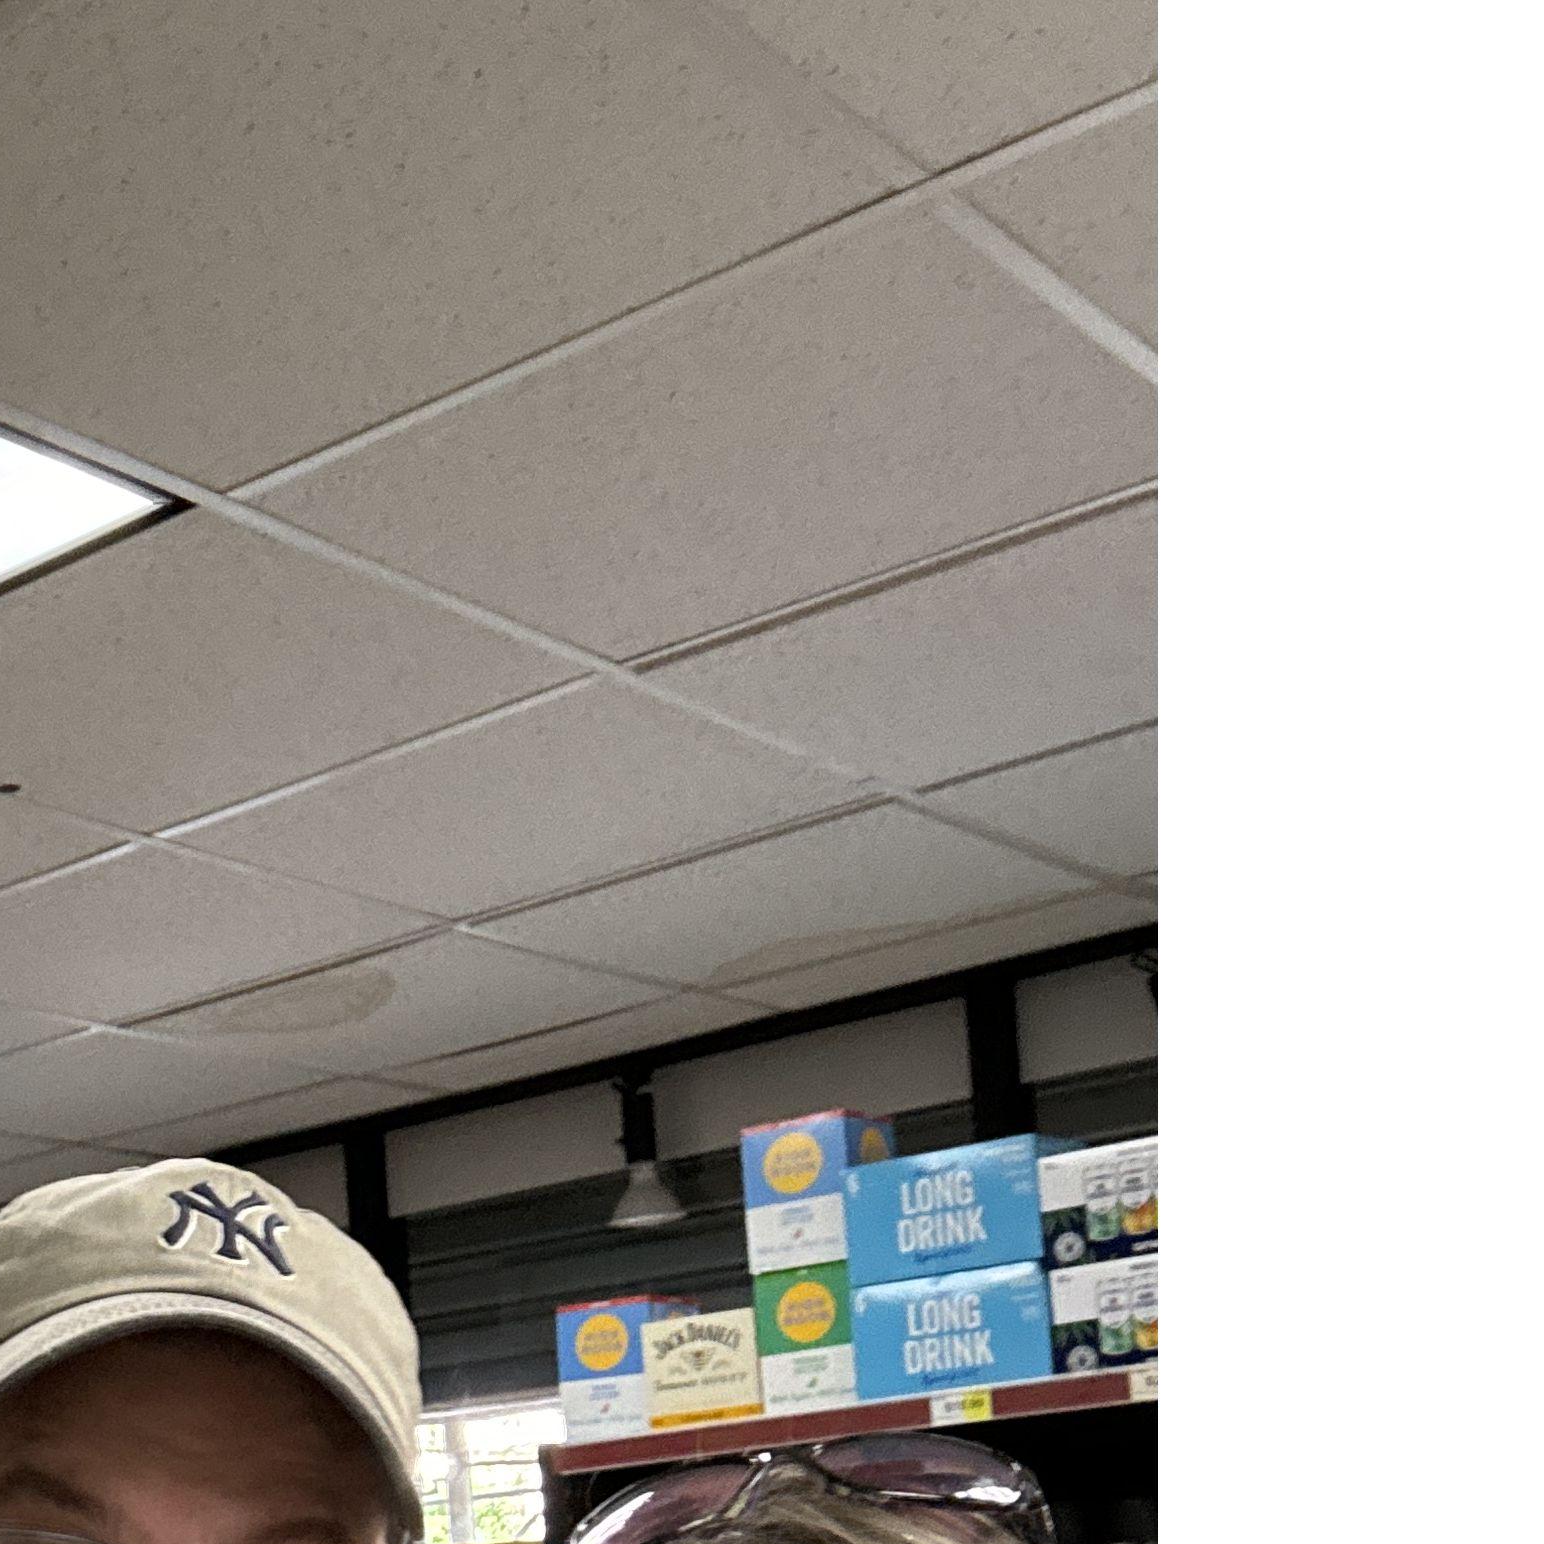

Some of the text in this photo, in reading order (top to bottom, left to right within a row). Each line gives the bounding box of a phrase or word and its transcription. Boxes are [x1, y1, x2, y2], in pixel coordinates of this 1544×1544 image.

[899, 1169, 976, 1215] LONG
[158, 1181, 297, 1279] NY
[896, 1205, 988, 1255] DRINK
[906, 1292, 983, 1337] LONG
[903, 1329, 995, 1375] DRINK
